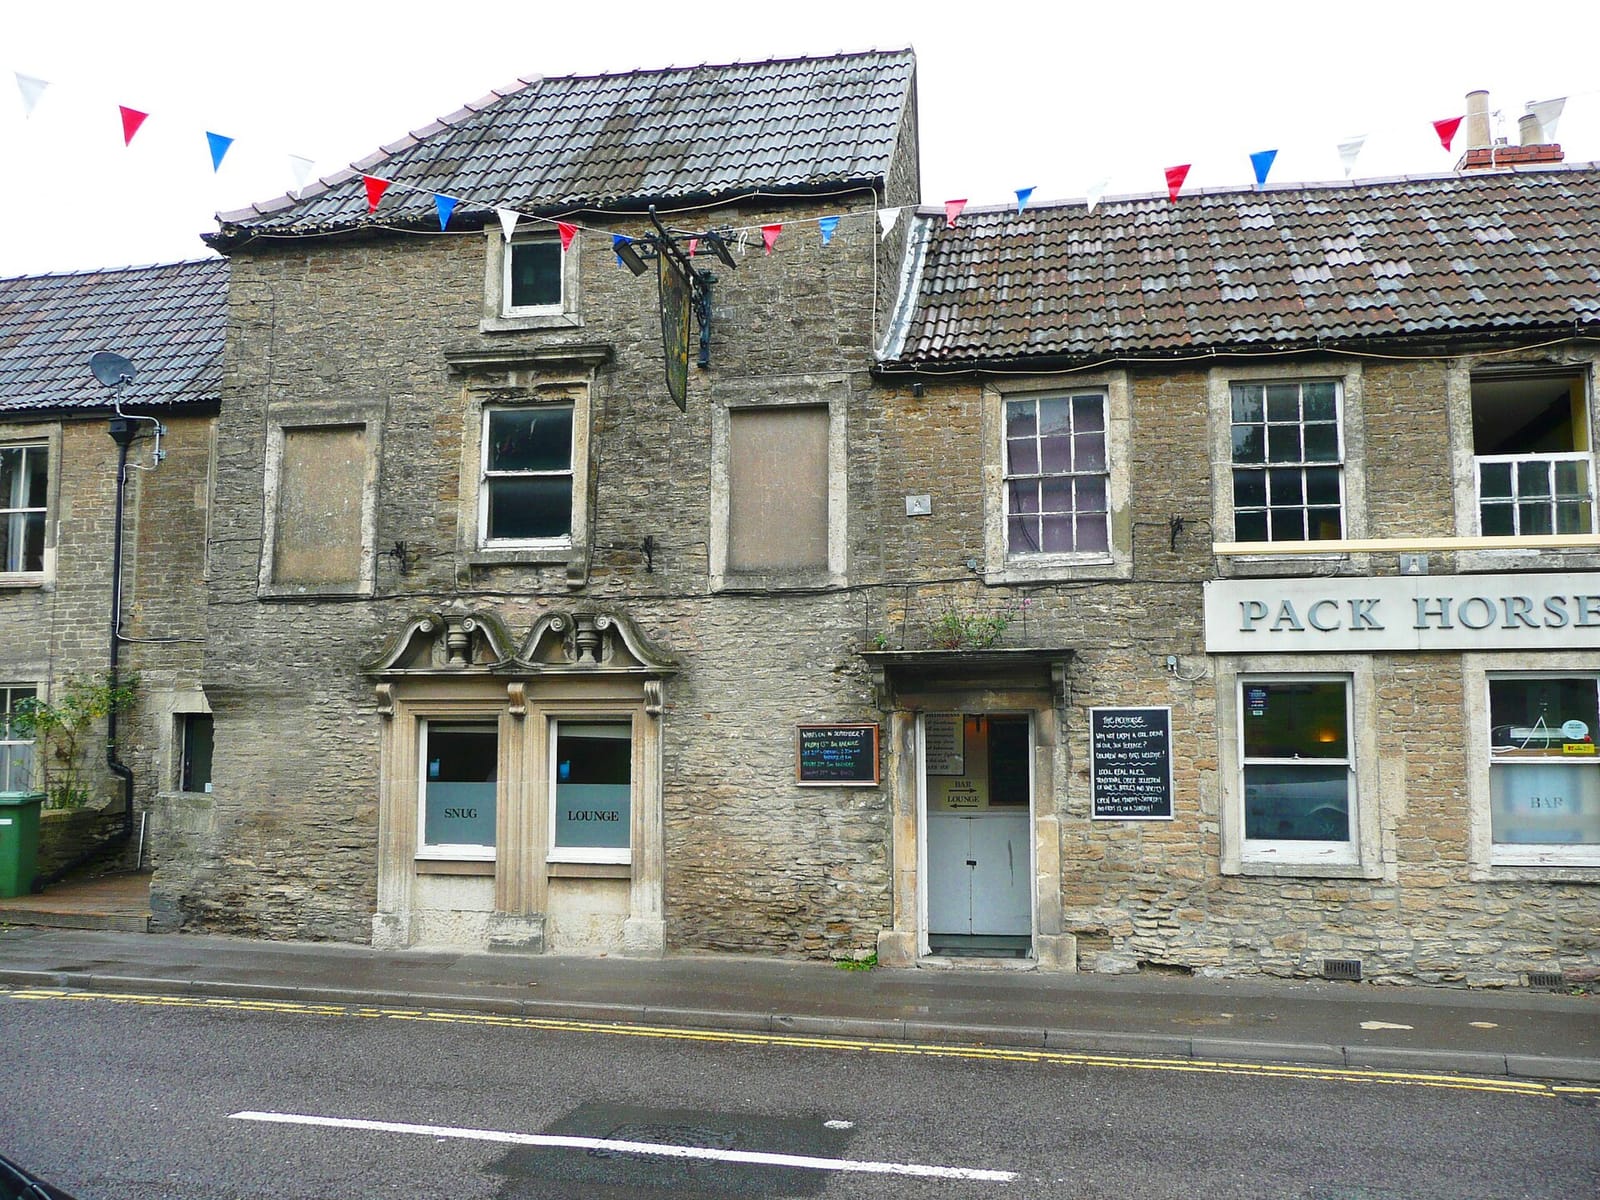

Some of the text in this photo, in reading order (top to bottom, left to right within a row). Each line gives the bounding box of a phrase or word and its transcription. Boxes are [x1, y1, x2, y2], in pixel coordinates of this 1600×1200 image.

[1239, 595, 1600, 633] PACK HORSE
[947, 795, 979, 803] LOUNGE
[444, 808, 477, 819] SNUG
[568, 810, 619, 822] LOUNGE
